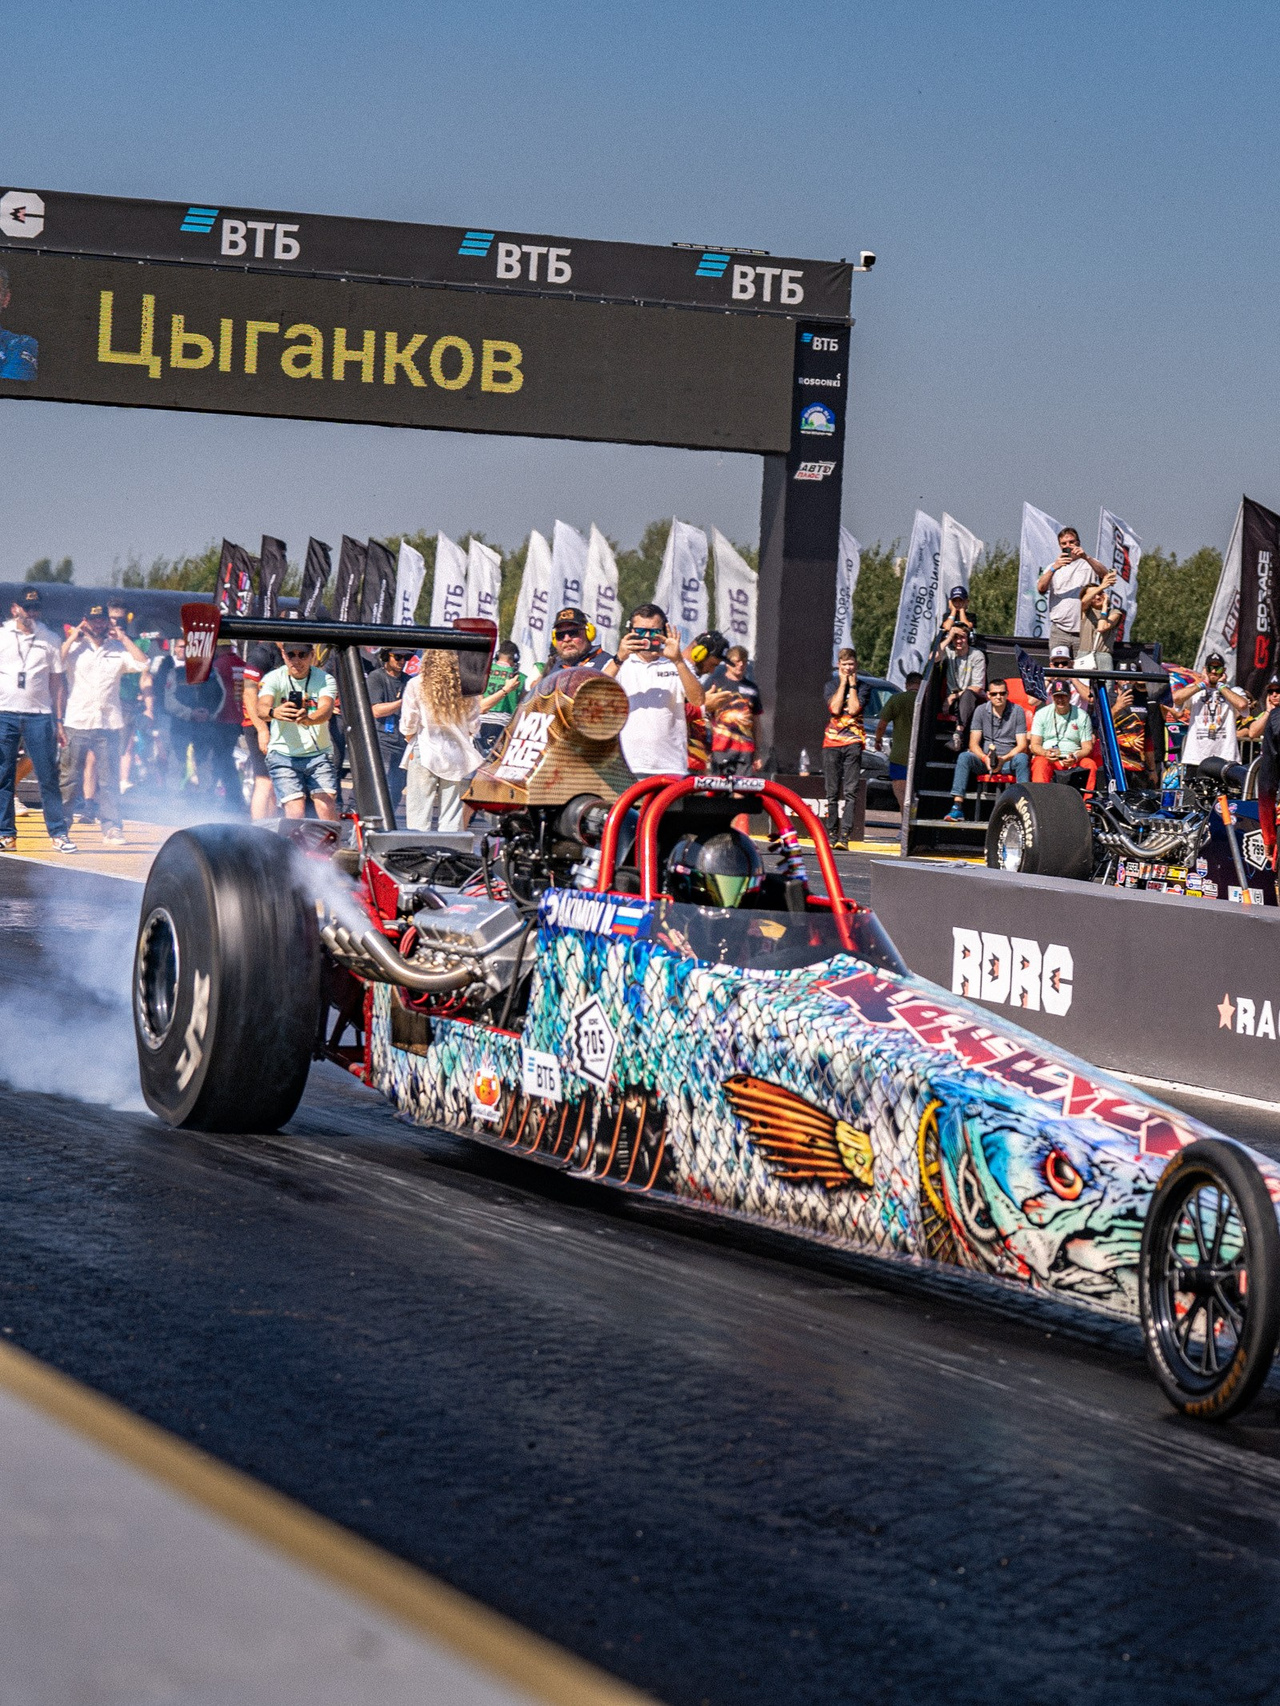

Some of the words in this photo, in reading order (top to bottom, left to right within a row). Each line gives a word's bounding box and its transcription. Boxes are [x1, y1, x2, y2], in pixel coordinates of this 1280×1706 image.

[221, 219, 301, 261] ВТБ
[496, 243, 573, 284] ВТБ
[731, 265, 804, 305] ВТБ
[97, 290, 526, 395] Цыганков
[812, 337, 839, 351] ВТБ
[477, 591, 493, 619] ТБ
[529, 588, 548, 631] ВТБ
[563, 578, 580, 608] ТБ
[596, 585, 616, 628] ВТБ
[729, 588, 749, 635] ВТБ
[907, 586, 928, 645] БЫКОВО
[952, 926, 1074, 1017] RDRC
[584, 1030, 605, 1056] 705
[537, 1064, 556, 1091] ВТБ
